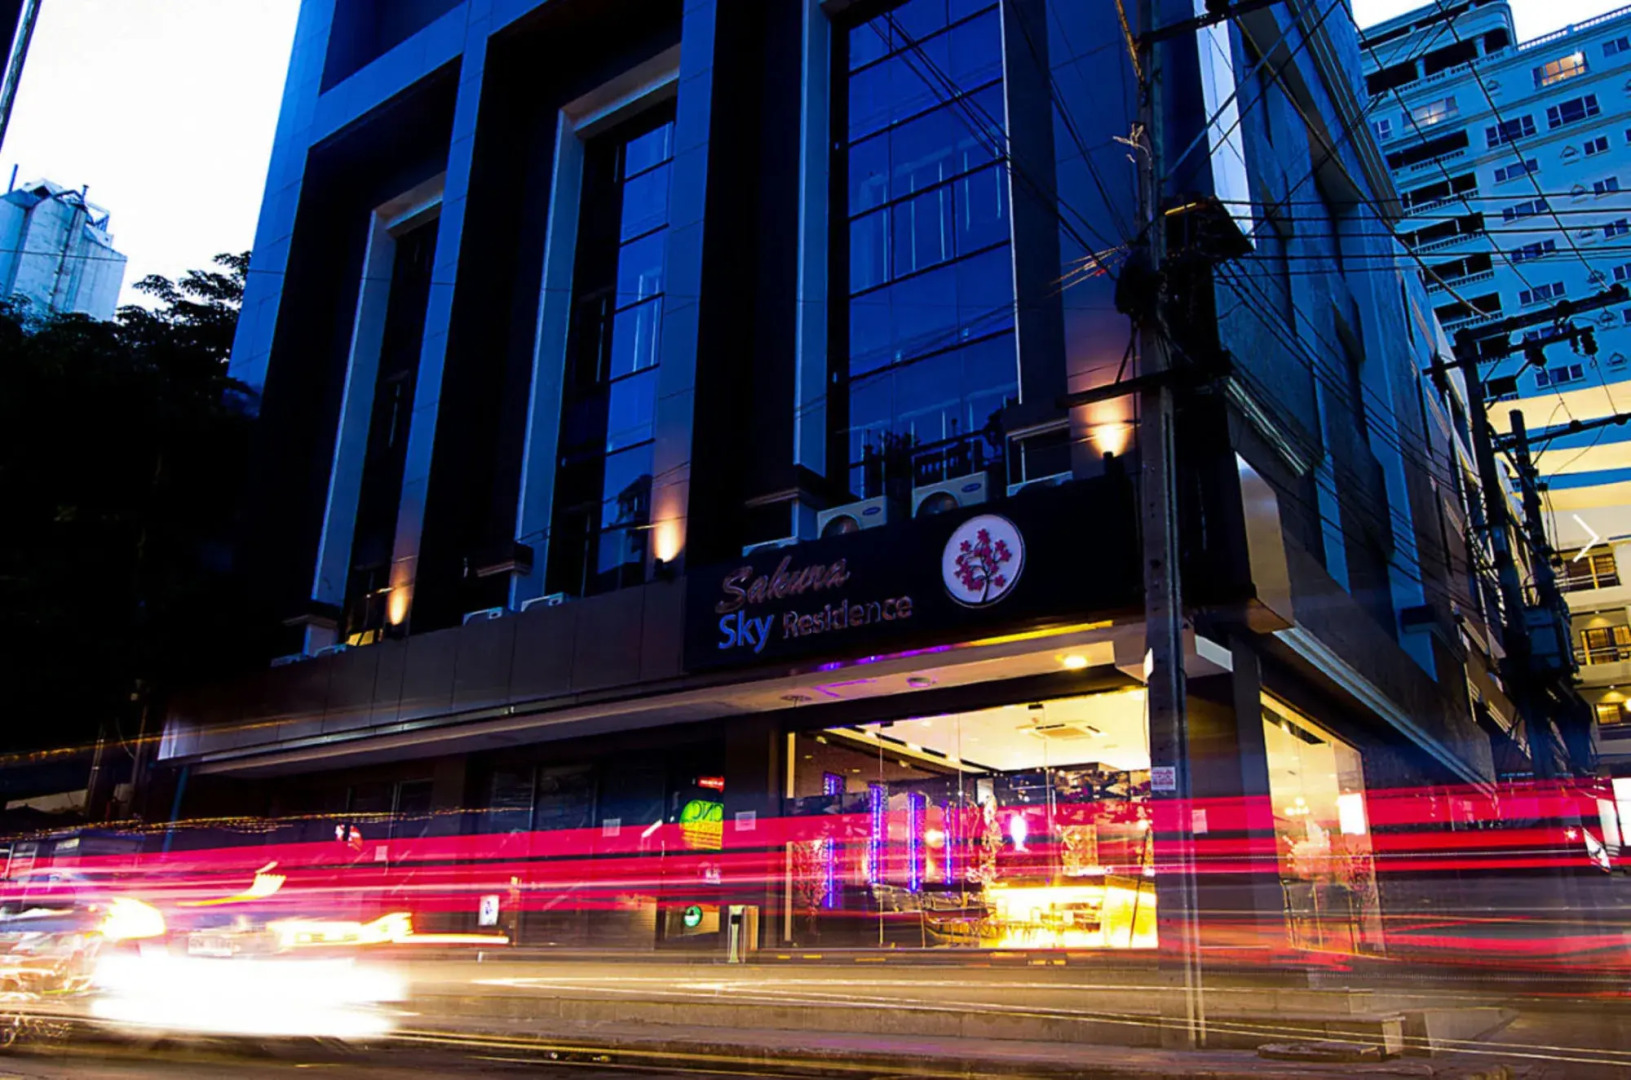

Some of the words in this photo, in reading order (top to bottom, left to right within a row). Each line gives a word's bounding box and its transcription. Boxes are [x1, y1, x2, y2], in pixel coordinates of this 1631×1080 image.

[715, 556, 850, 612] Sakura
[718, 610, 774, 653] Sky
[783, 596, 913, 639] Residence
